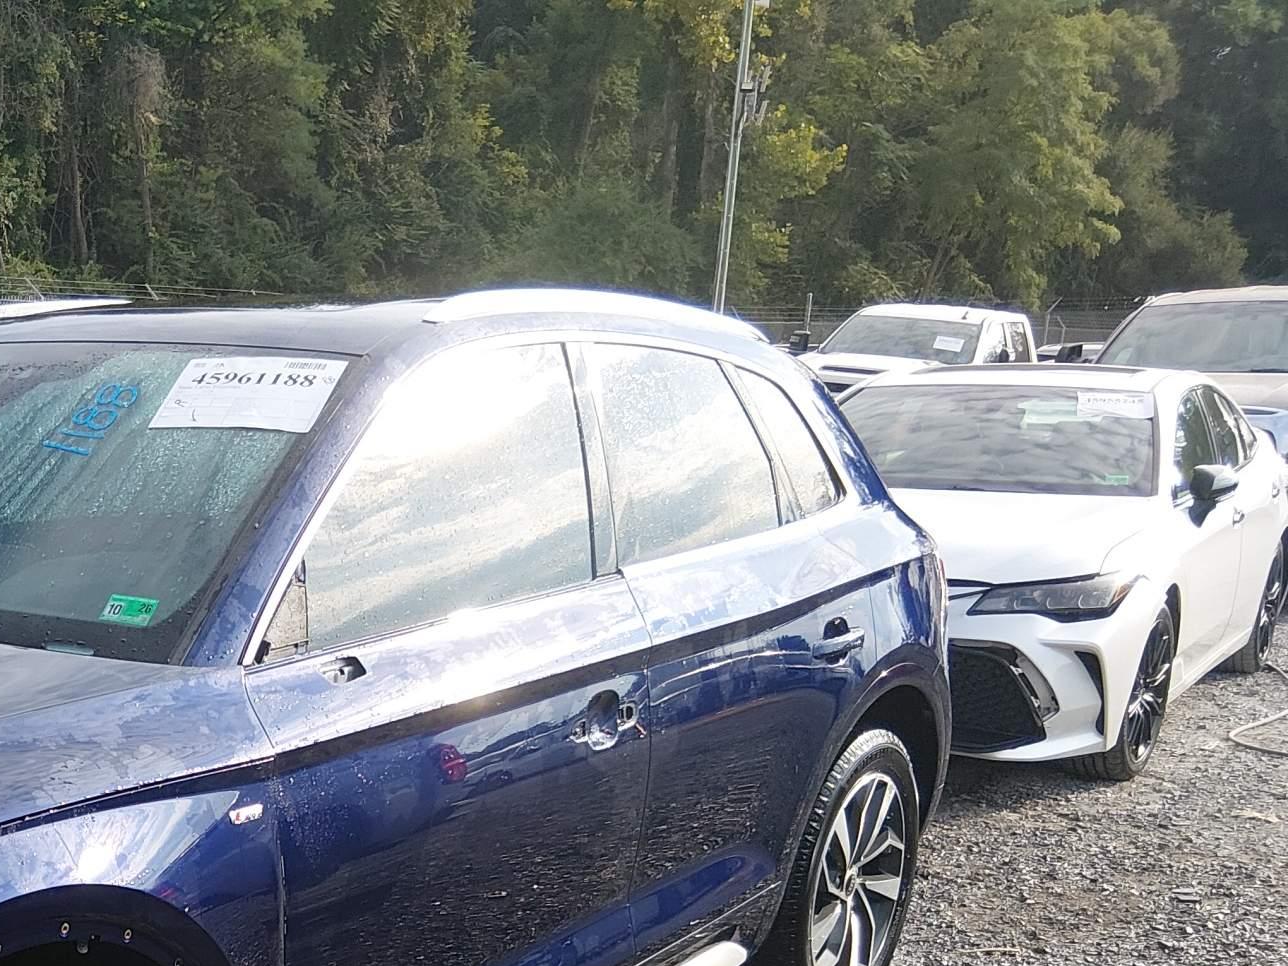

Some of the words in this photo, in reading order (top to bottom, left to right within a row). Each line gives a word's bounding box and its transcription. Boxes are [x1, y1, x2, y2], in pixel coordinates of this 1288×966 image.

[191, 371, 317, 388] 45961188
[41, 383, 138, 456] 1188
[108, 603, 122, 615] 10
